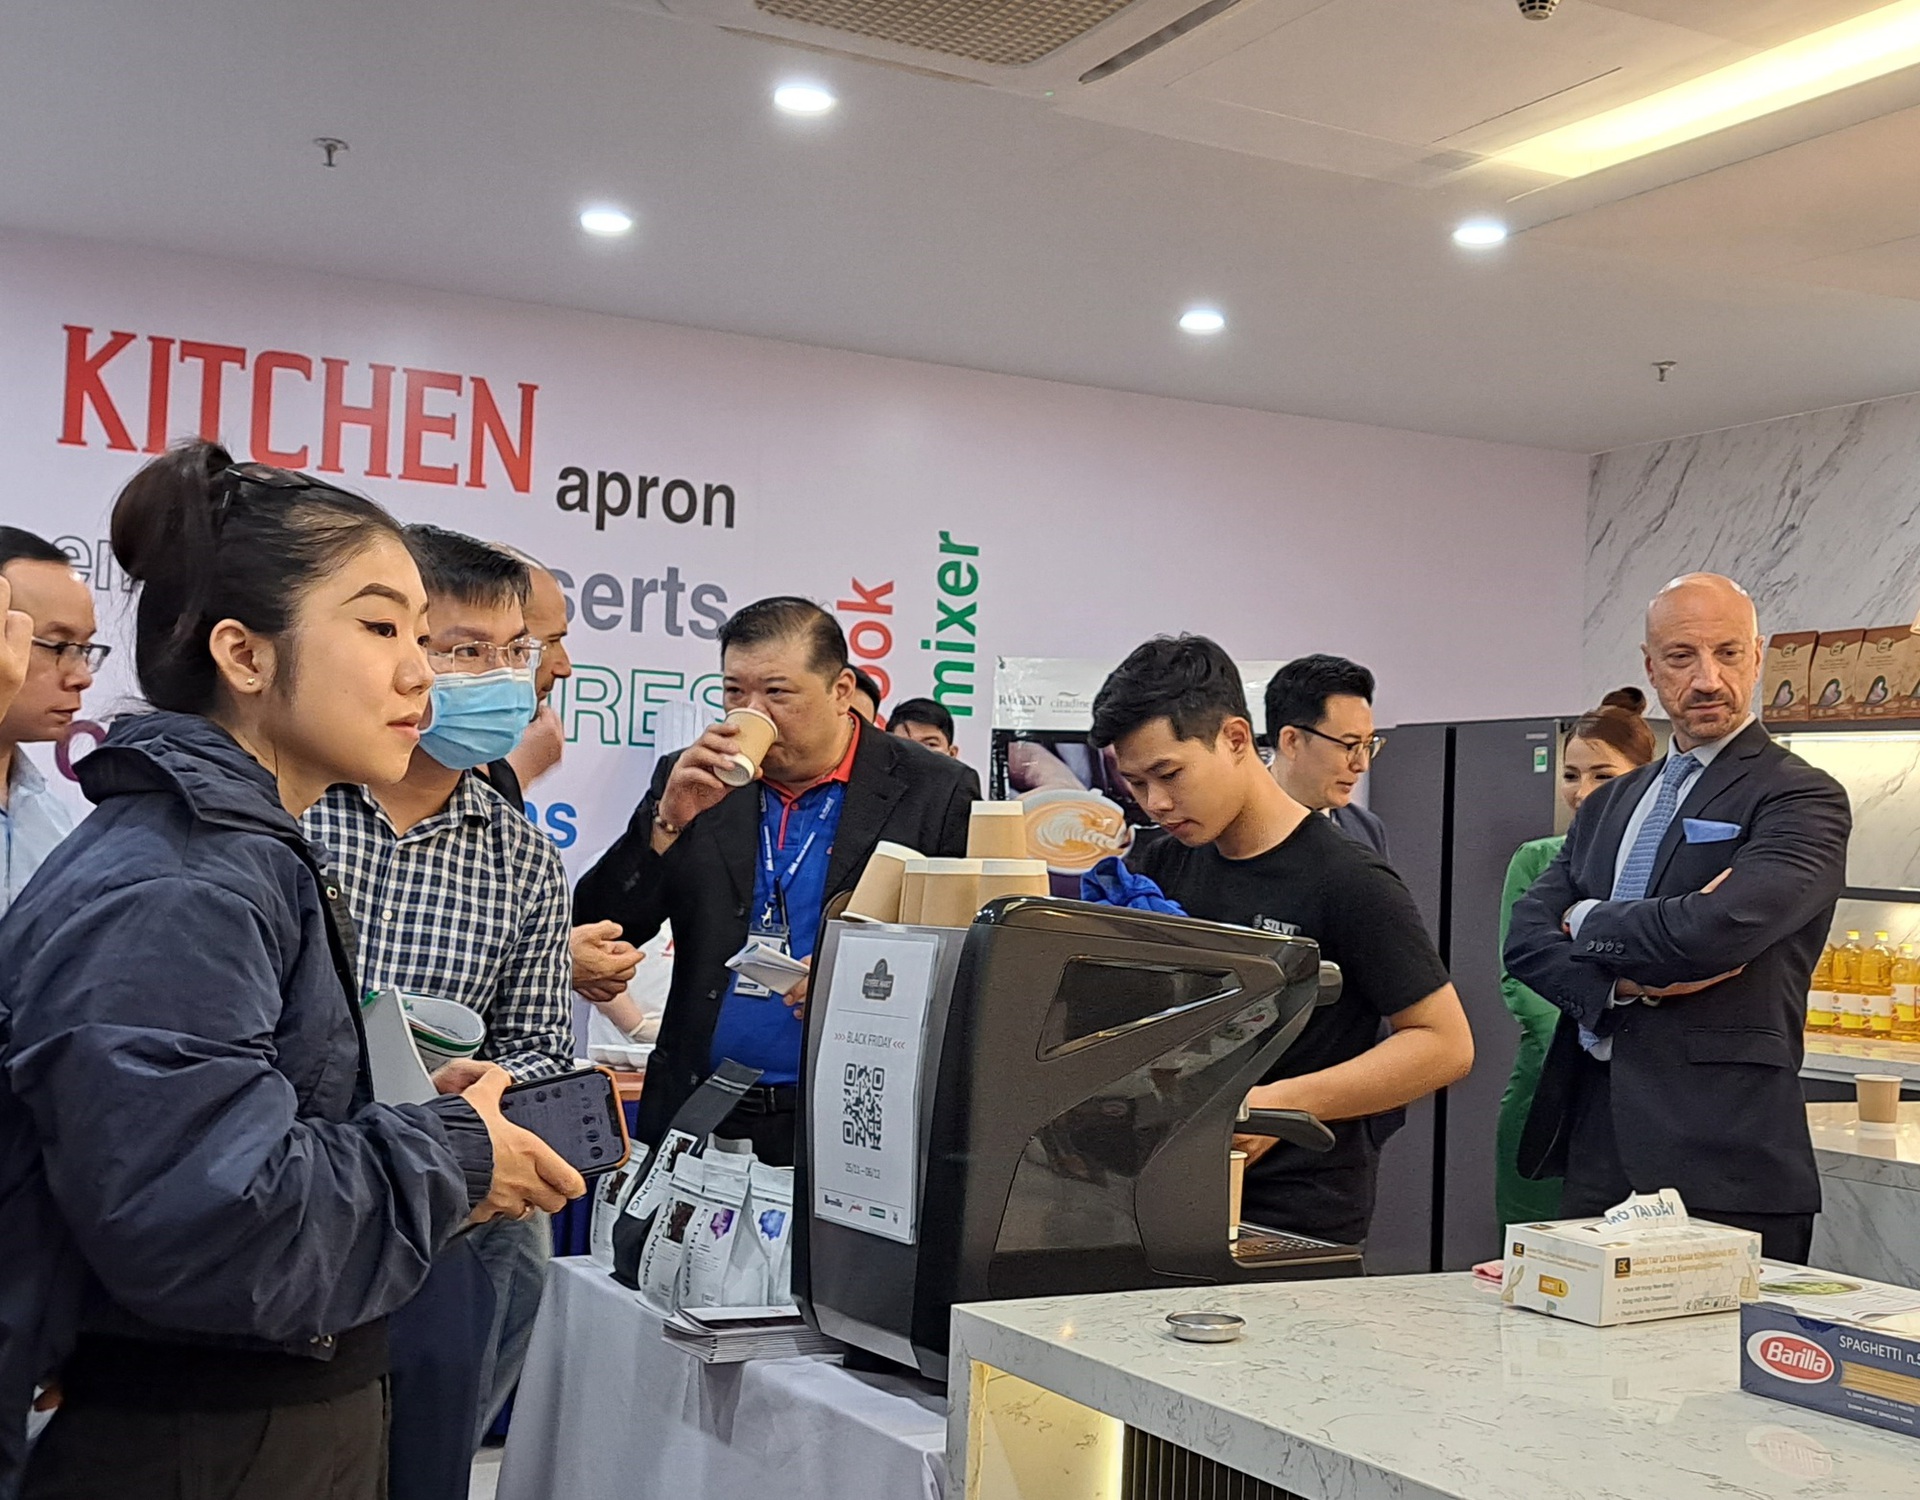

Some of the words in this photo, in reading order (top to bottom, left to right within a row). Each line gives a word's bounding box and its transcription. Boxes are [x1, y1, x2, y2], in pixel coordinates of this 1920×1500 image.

[57, 324, 539, 493] KITCHEN
[556, 466, 735, 531] apron
[836, 577, 894, 731] ook
[920, 530, 979, 717] mixer
[629, 1167, 660, 1212] NONG
[1766, 1341, 1827, 1374] Barilla
[1839, 1335, 1902, 1361] SPAGHETTI
